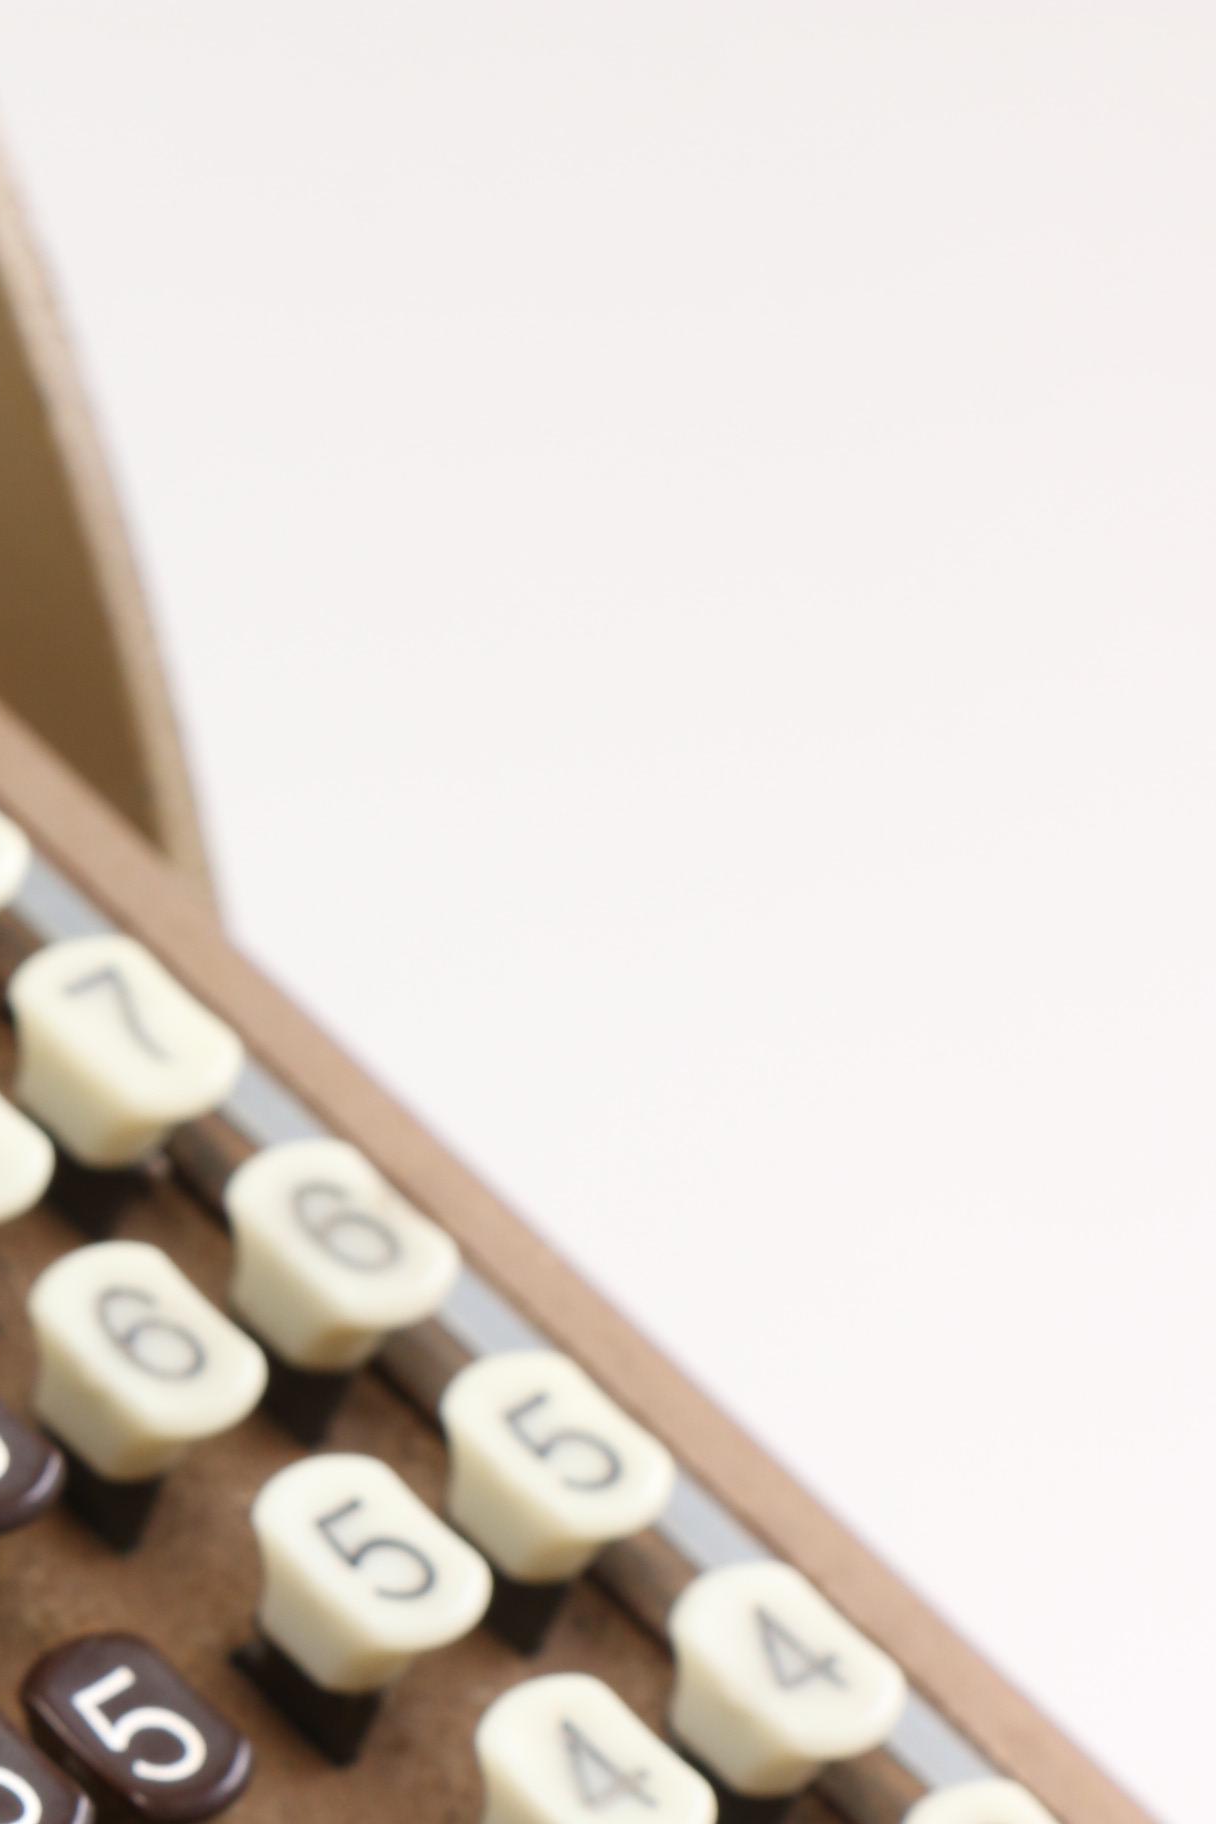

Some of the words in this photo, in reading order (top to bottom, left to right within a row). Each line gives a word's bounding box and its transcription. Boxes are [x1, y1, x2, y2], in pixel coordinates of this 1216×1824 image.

[62, 964, 168, 1061] 7
[290, 1181, 404, 1271] 6
[96, 1287, 209, 1381] 6
[502, 1392, 625, 1492] 5
[314, 1498, 438, 1601] 5
[752, 1605, 846, 1689] 4
[73, 1668, 205, 1781] 5
[558, 1718, 656, 1808] 4
